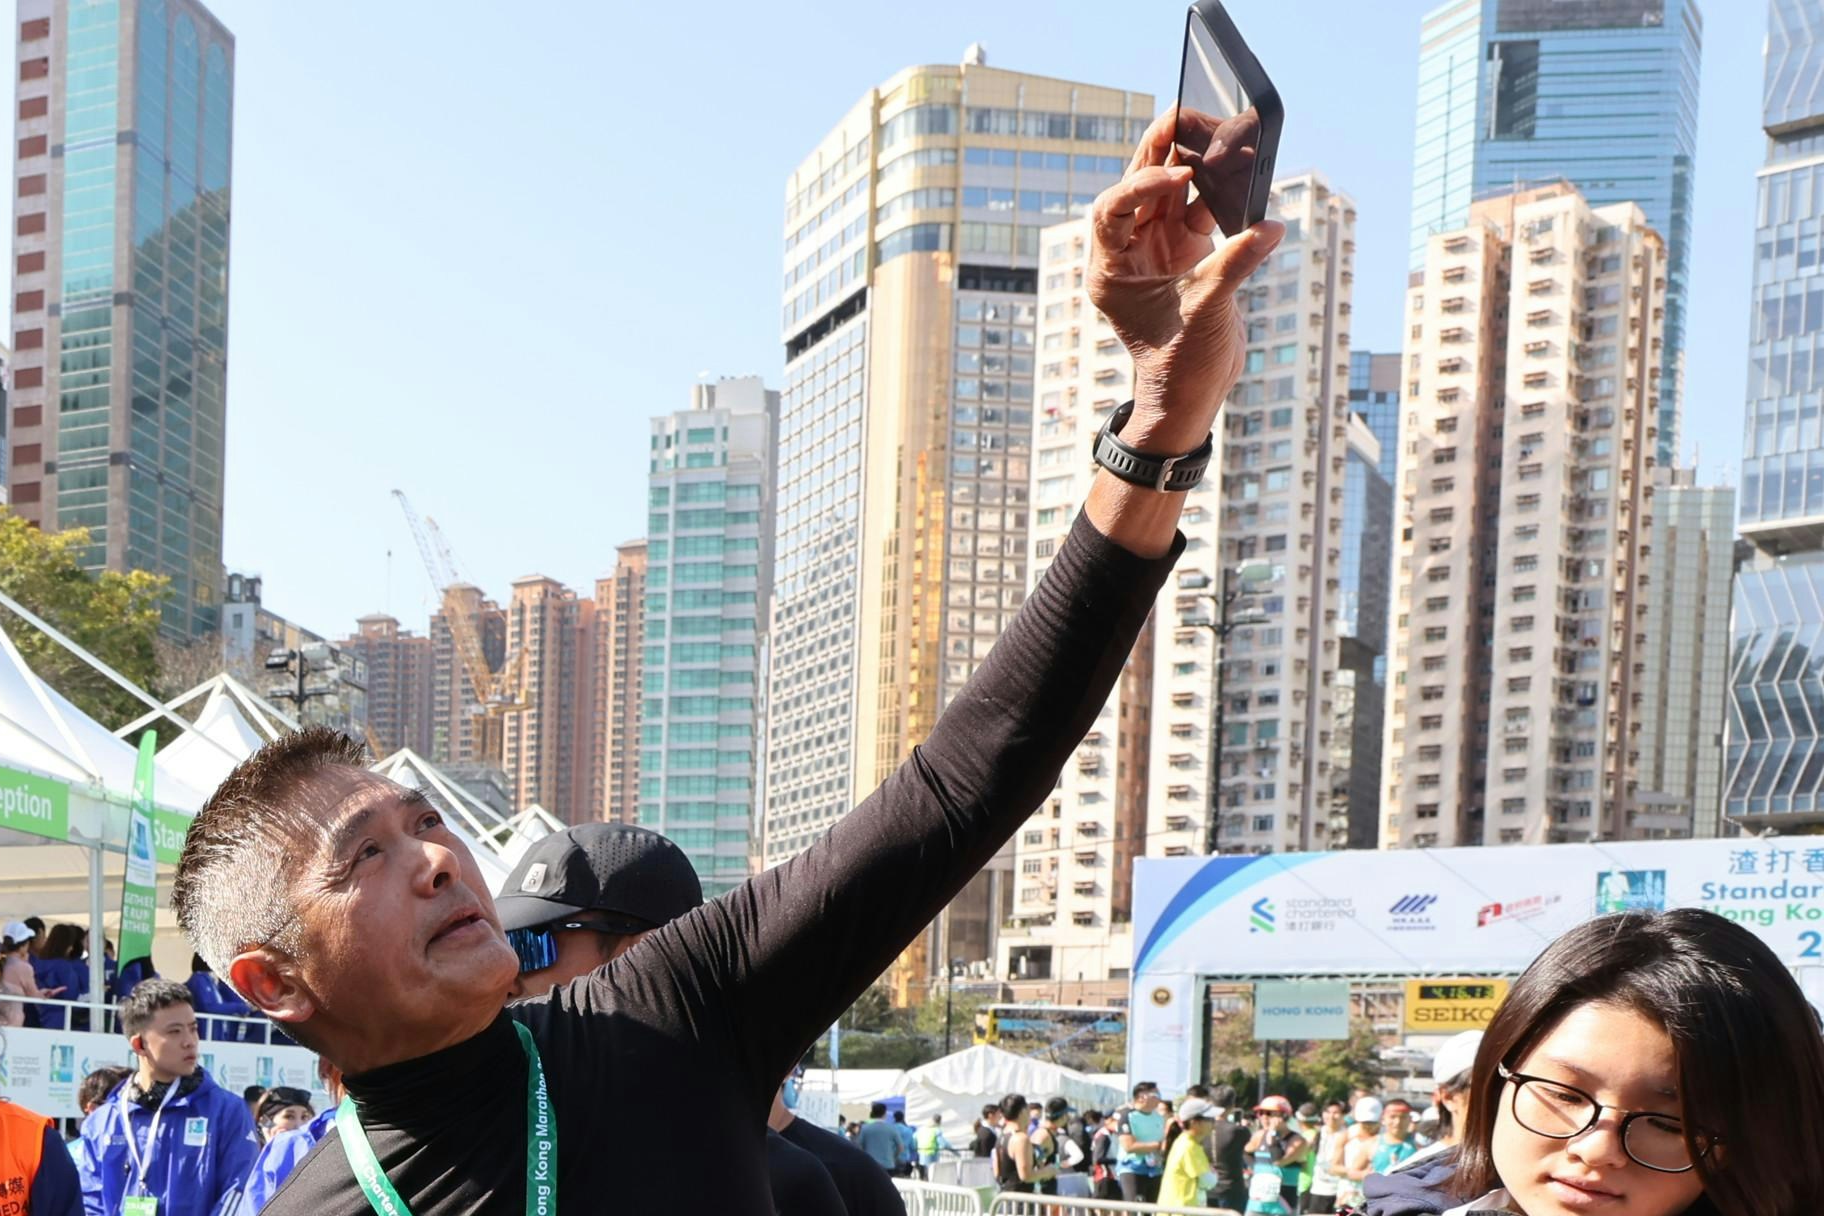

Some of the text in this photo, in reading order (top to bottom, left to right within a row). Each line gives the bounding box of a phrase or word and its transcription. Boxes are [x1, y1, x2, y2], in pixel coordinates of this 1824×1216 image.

[154, 818, 185, 850] Stan
[1729, 848, 1824, 874] 渣打香
[1701, 879, 1823, 900] Standar
[1786, 904, 1824, 921] Ko
[1262, 1006, 1344, 1016] HONG KONG
[1414, 1007, 1497, 1022] SEIKO
[535, 1073, 549, 1136] Marathon
[535, 1140, 551, 1181] Kong
